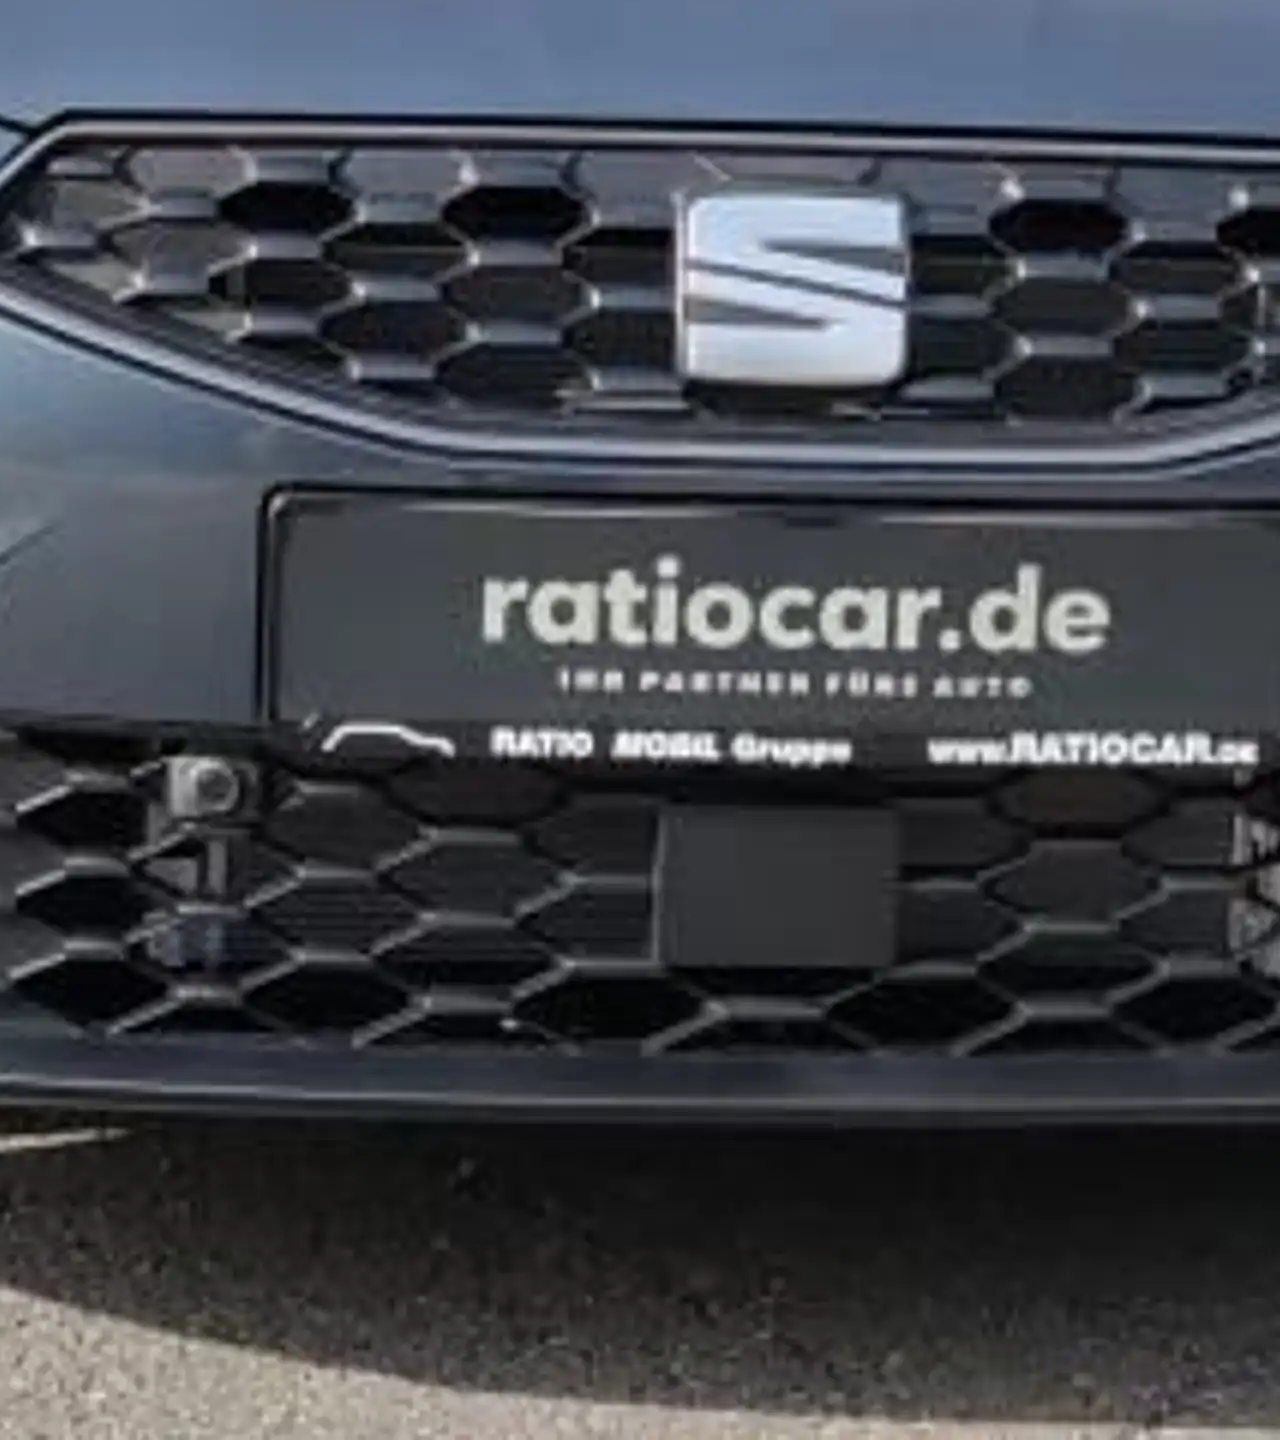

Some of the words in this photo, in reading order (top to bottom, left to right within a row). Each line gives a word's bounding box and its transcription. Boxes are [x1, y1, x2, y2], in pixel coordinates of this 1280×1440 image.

[482, 553, 1112, 655] ratiocar.de
[559, 668, 624, 694] IHR
[638, 670, 811, 697] PARTNER
[932, 675, 1035, 700] AUTO
[489, 726, 595, 760] RATIO
[609, 730, 720, 763] MOBIL
[729, 732, 853, 771] Gruppe
